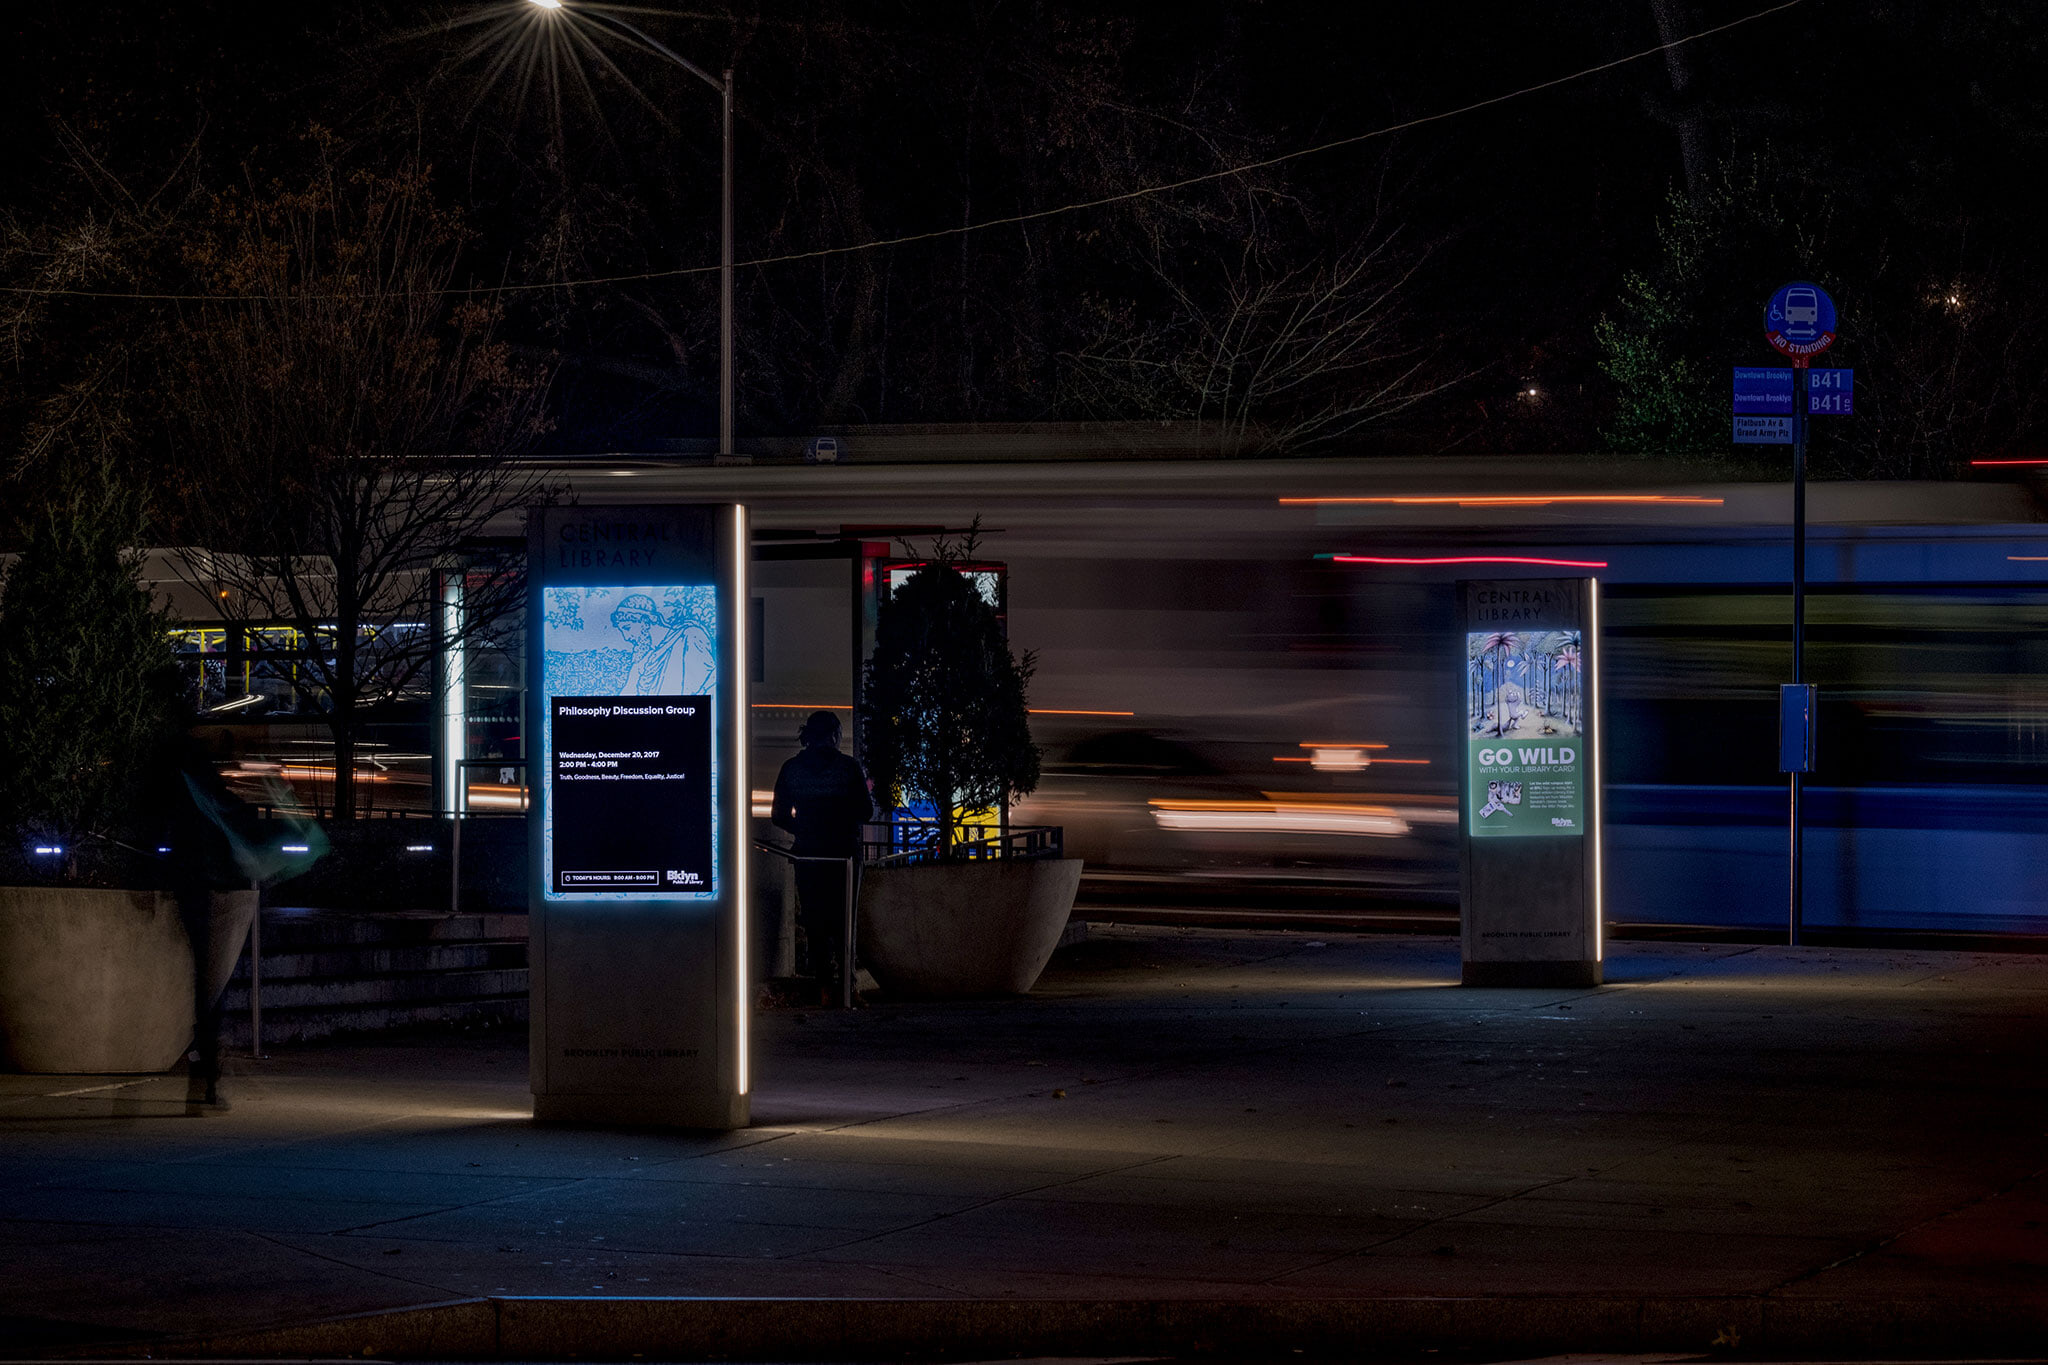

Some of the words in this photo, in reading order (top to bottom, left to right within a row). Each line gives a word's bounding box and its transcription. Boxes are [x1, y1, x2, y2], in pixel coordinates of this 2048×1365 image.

[1774, 334, 1788, 348] NO
[1789, 335, 1831, 354] STANDING
[1766, 370, 1791, 381] Brooklyn
[1811, 372, 1841, 388] B41
[1766, 393, 1791, 403] Brooklyn
[1811, 394, 1841, 411] B41
[1767, 419, 1777, 427] Av
[1737, 428, 1758, 437] Grand
[1759, 428, 1777, 438] Army
[1778, 428, 1789, 437] Plz
[559, 523, 670, 542] CENTRAL
[560, 549, 656, 568] LIBRARY
[1477, 590, 1552, 604] CENTRAL
[1478, 608, 1541, 620] LIBRARY
[559, 706, 611, 717] Philosophy
[613, 706, 664, 715] Discussion
[666, 706, 696, 717] Group
[559, 752, 598, 760] Wednesday,
[1478, 748, 1513, 766] GO
[1518, 747, 1576, 765] WILD
[1479, 766, 1498, 774] WITH
[564, 1048, 618, 1058] BROOKLYN
[622, 1048, 654, 1057] PUBLIC
[657, 1048, 699, 1057] LIBRARY
